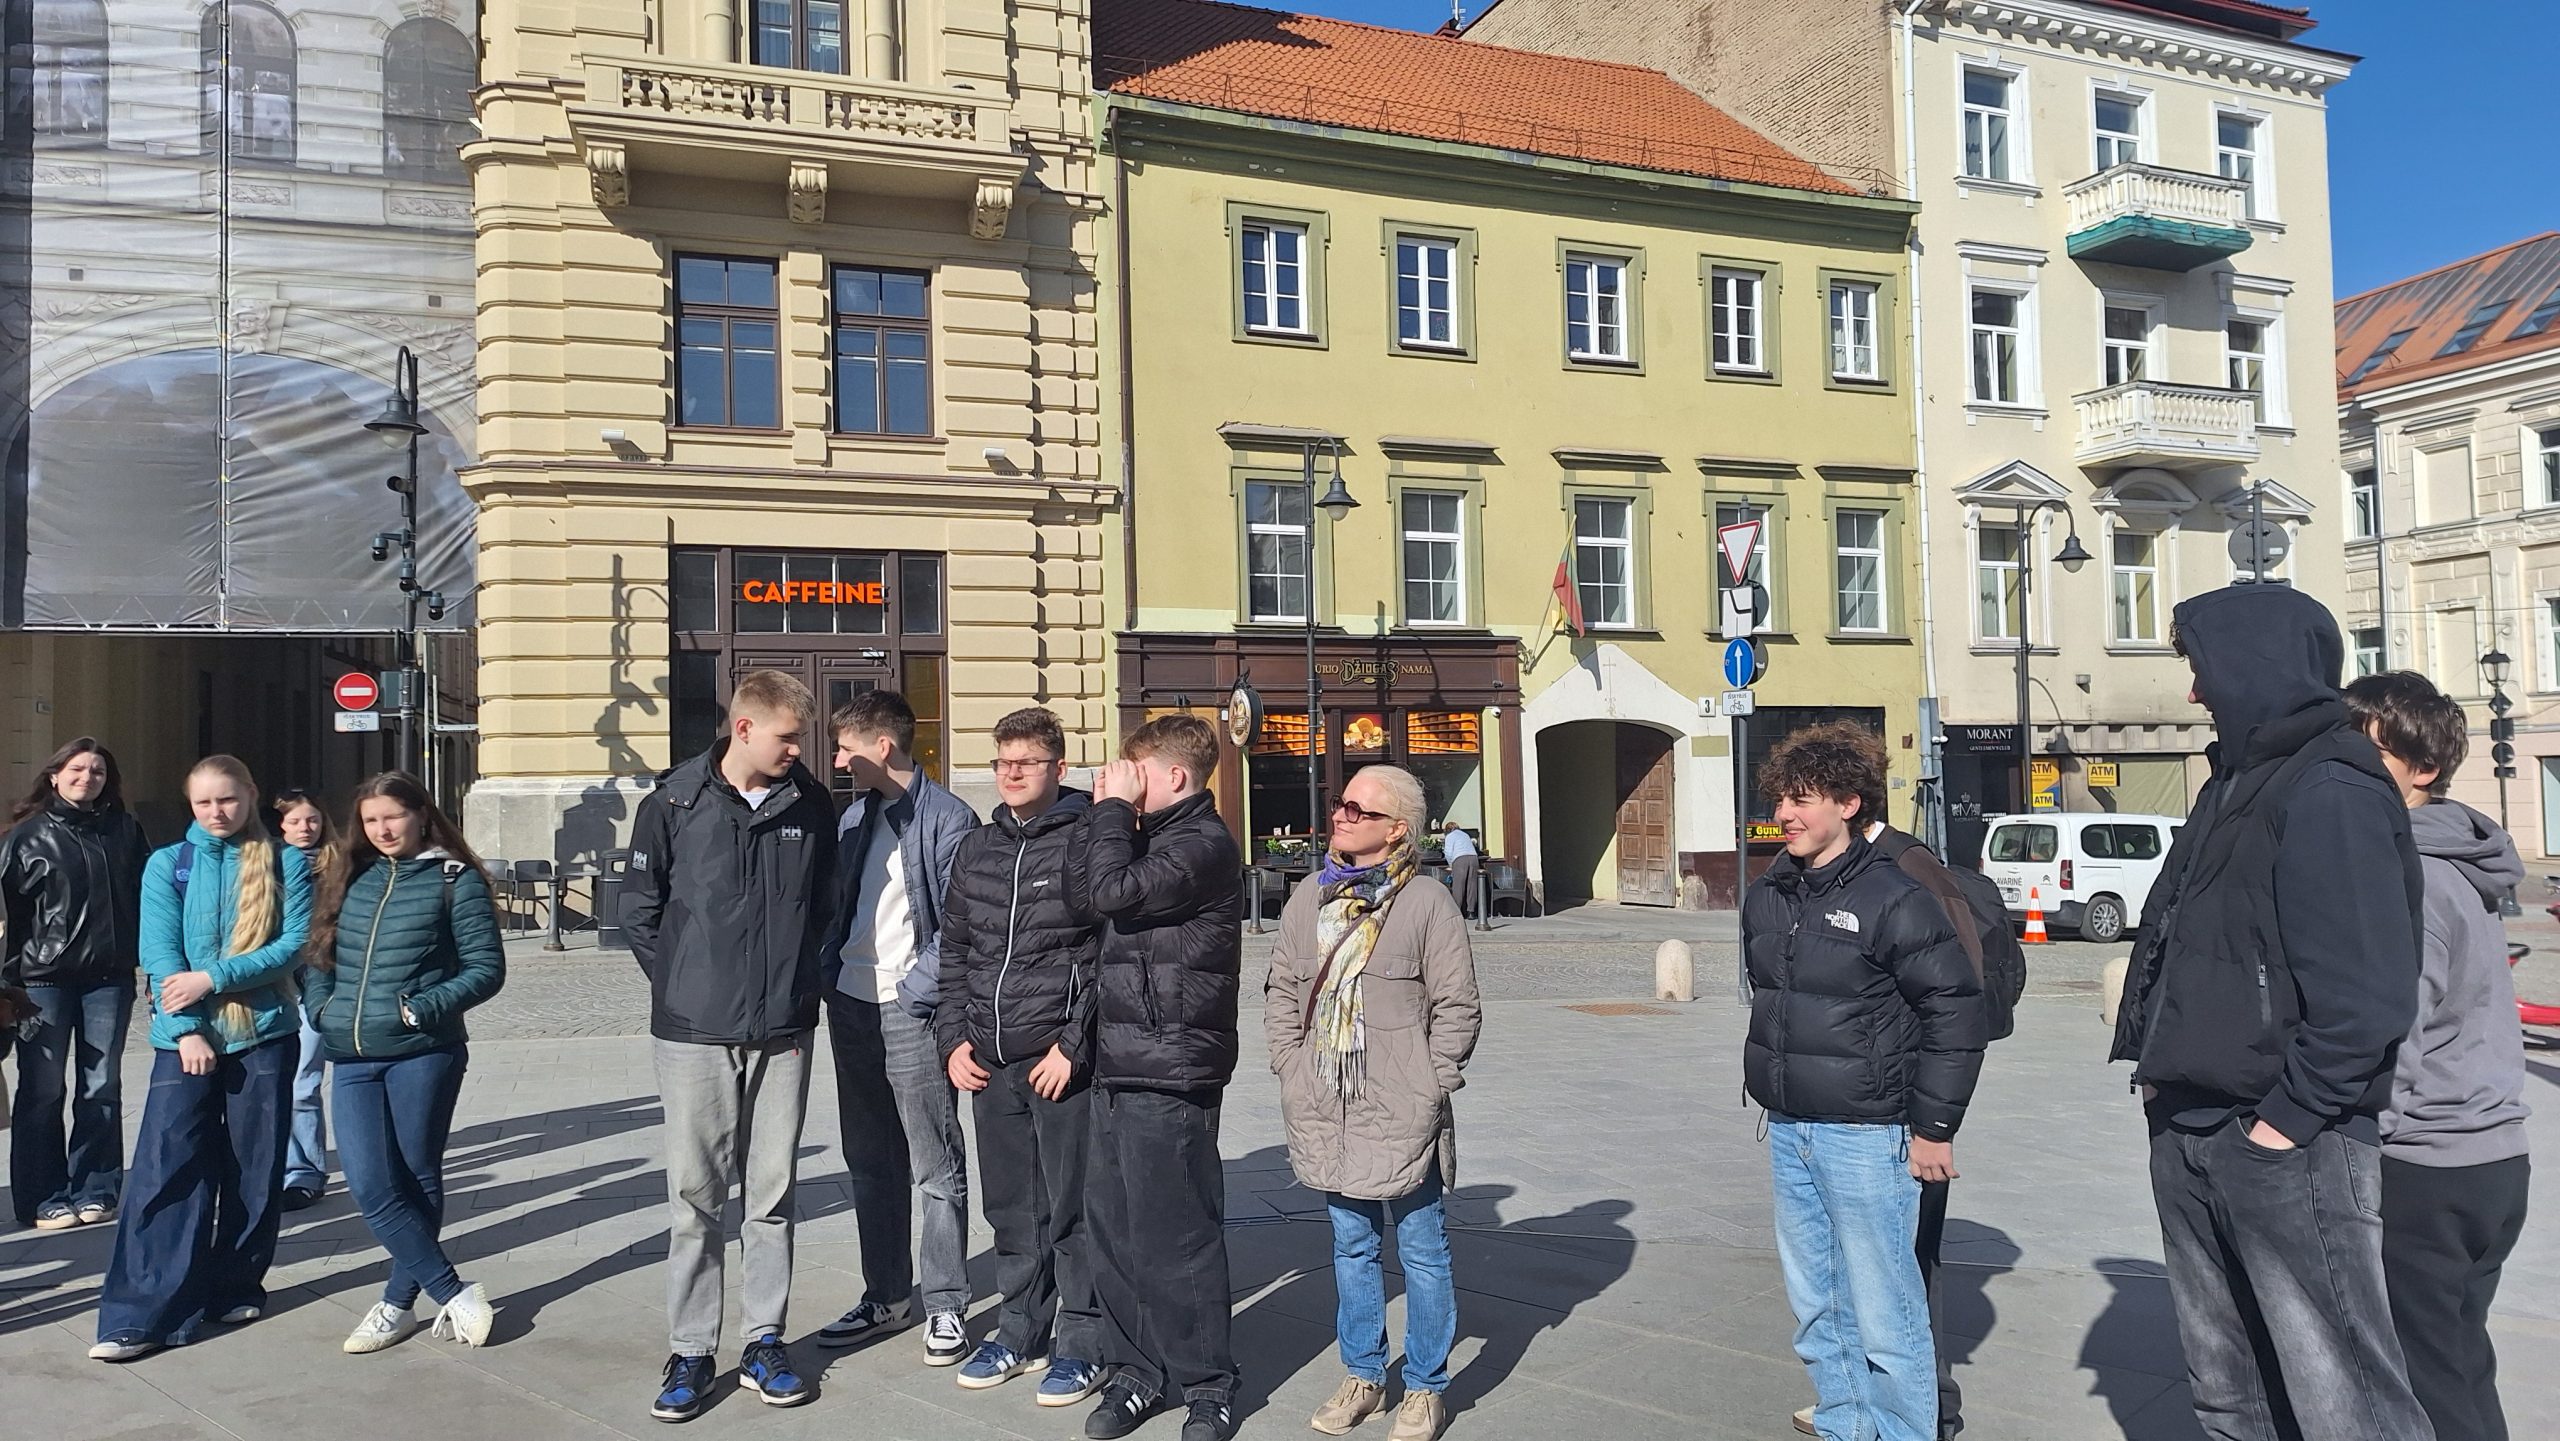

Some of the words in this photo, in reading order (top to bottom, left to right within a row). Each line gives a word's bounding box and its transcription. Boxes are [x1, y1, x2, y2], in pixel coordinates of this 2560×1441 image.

[743, 579, 883, 604] CAFFEINE
[1315, 664, 1339, 674] ŪRIO
[1341, 659, 1397, 683] DŽIUGAS
[1401, 664, 1433, 675] NAMAI
[1704, 699, 1711, 714] 3
[1966, 728, 2013, 740] MORANT
[2032, 763, 2052, 774] ATM
[2090, 766, 2114, 777] ATM
[2034, 796, 2053, 805] ATM
[782, 825, 802, 837] HH
[1825, 912, 1849, 924] NORTH
[1831, 919, 1849, 930] FACE
